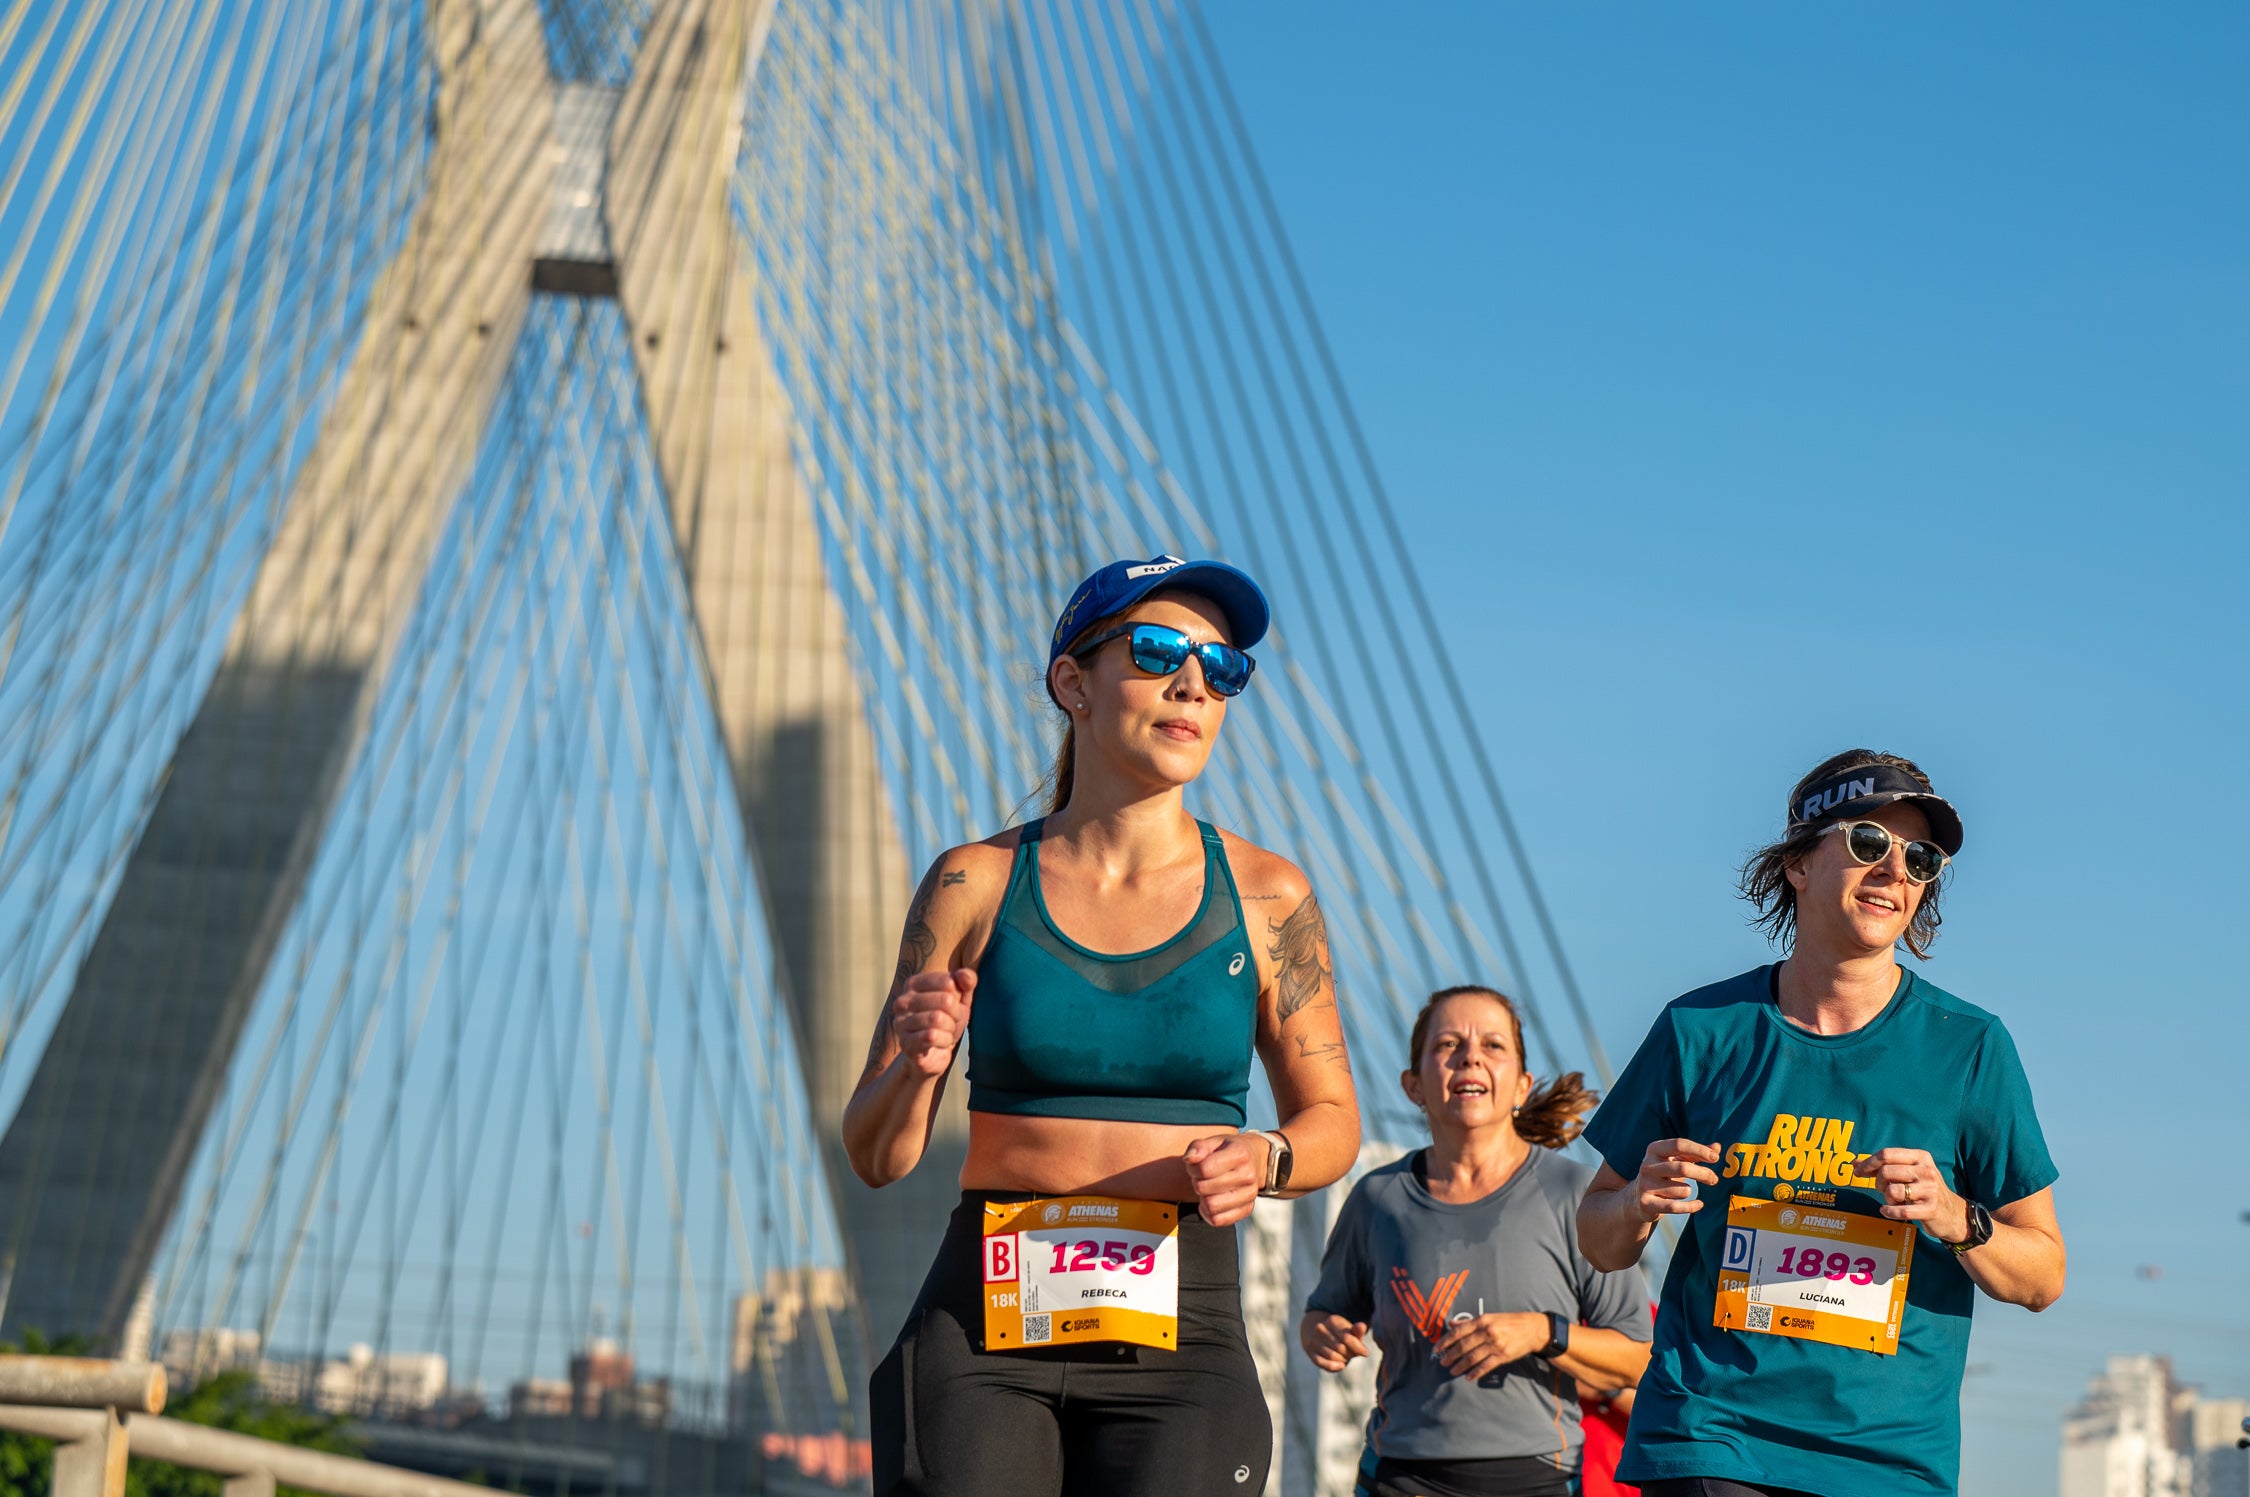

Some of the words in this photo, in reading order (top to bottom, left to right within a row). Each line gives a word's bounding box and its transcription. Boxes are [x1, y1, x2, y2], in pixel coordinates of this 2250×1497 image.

[1803, 777, 1875, 821] RUN
[1767, 1114, 1855, 1152] RUN
[1796, 1189, 1836, 1203] ATHENAS
[1068, 1204, 1119, 1217] ATHENAS
[1801, 1215, 1847, 1230] ATHENAS
[1728, 1232, 1748, 1264] D
[993, 1241, 1010, 1276] B
[1049, 1240, 1156, 1275] 1259
[1776, 1246, 1877, 1286] 1893
[1081, 1288, 1128, 1299] REBECA
[1722, 1279, 1747, 1294] 18K
[990, 1292, 1018, 1308] 18K
[1799, 1292, 1846, 1307] LUCIANA
[1886, 1323, 1897, 1340] 1893
